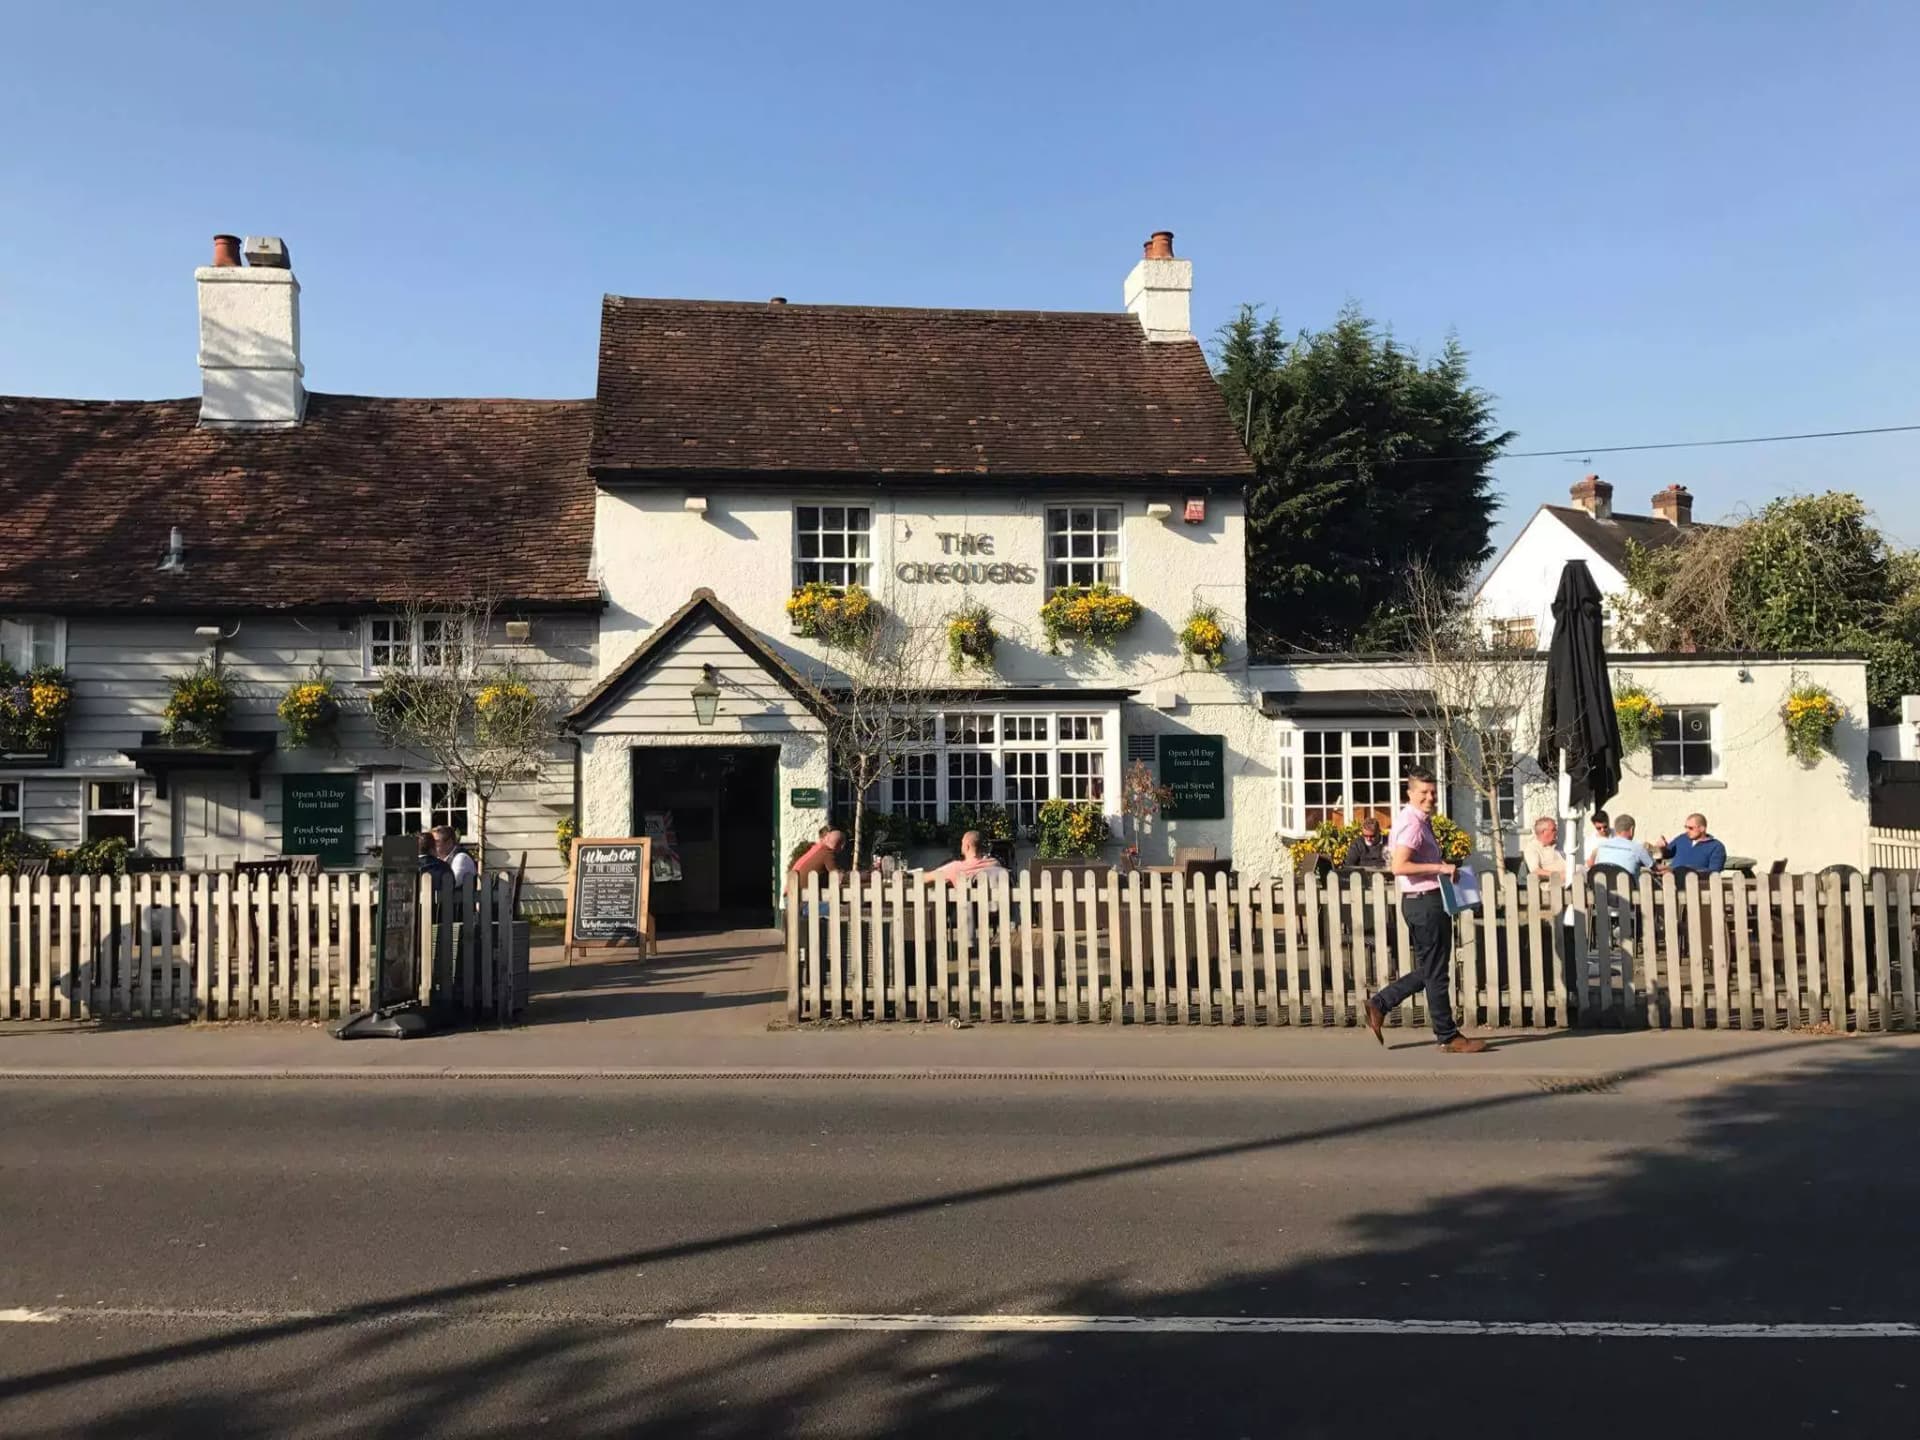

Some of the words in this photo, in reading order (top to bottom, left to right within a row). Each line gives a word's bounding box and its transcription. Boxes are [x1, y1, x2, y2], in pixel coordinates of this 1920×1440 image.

[935, 532, 995, 555] THE
[895, 561, 1039, 585] CHEQUERS
[1168, 749, 1188, 758] Open
[1190, 748, 1200, 757] All
[1201, 749, 1216, 758] Day
[1174, 759, 1192, 767] from
[1193, 759, 1210, 767] 11am
[1171, 782, 1188, 790] Food
[1190, 781, 1215, 790] Served
[291, 791, 314, 799] Open
[316, 790, 328, 798] All
[329, 790, 345, 799] Day
[1175, 792, 1183, 800] 11
[1185, 792, 1193, 800] to
[1194, 792, 1210, 801] 9pm
[293, 826, 314, 835] Food
[315, 825, 343, 834] Served
[298, 837, 306, 845] 11
[310, 837, 318, 845] to
[320, 837, 338, 846] 9pm
[619, 848, 637, 862] On
